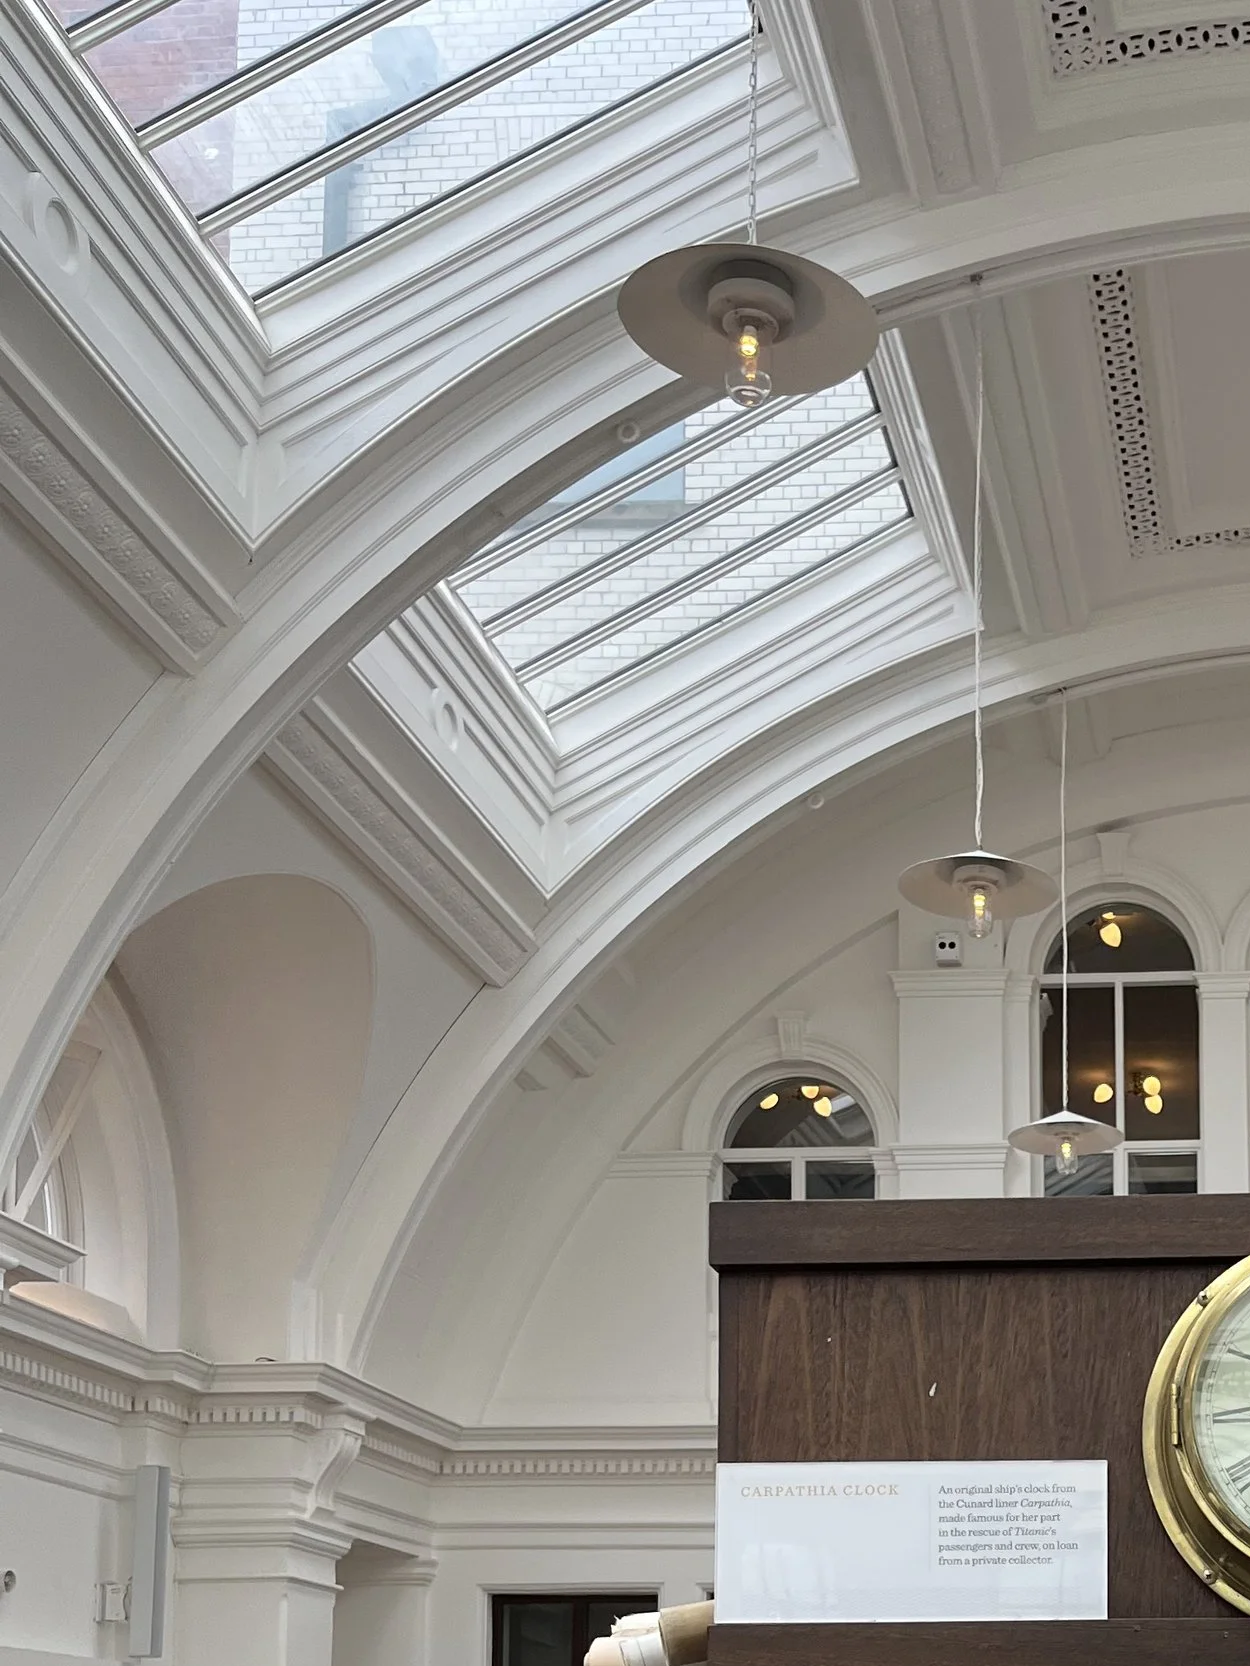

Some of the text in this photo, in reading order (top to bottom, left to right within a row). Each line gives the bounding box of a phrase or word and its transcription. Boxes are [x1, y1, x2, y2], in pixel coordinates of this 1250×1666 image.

[741, 1484, 899, 1498] CARPATHIA CLOCK
[938, 1484, 1076, 1496] An original ship's clock from
[938, 1498, 1073, 1510] the Cunard liner Carpathia,
[938, 1512, 1061, 1524] made famous for her part
[938, 1526, 1057, 1537] in the rescue of Titanic's
[938, 1540, 1079, 1553] passengers and crew, on loan
[938, 1555, 1054, 1567] from a private collector.
